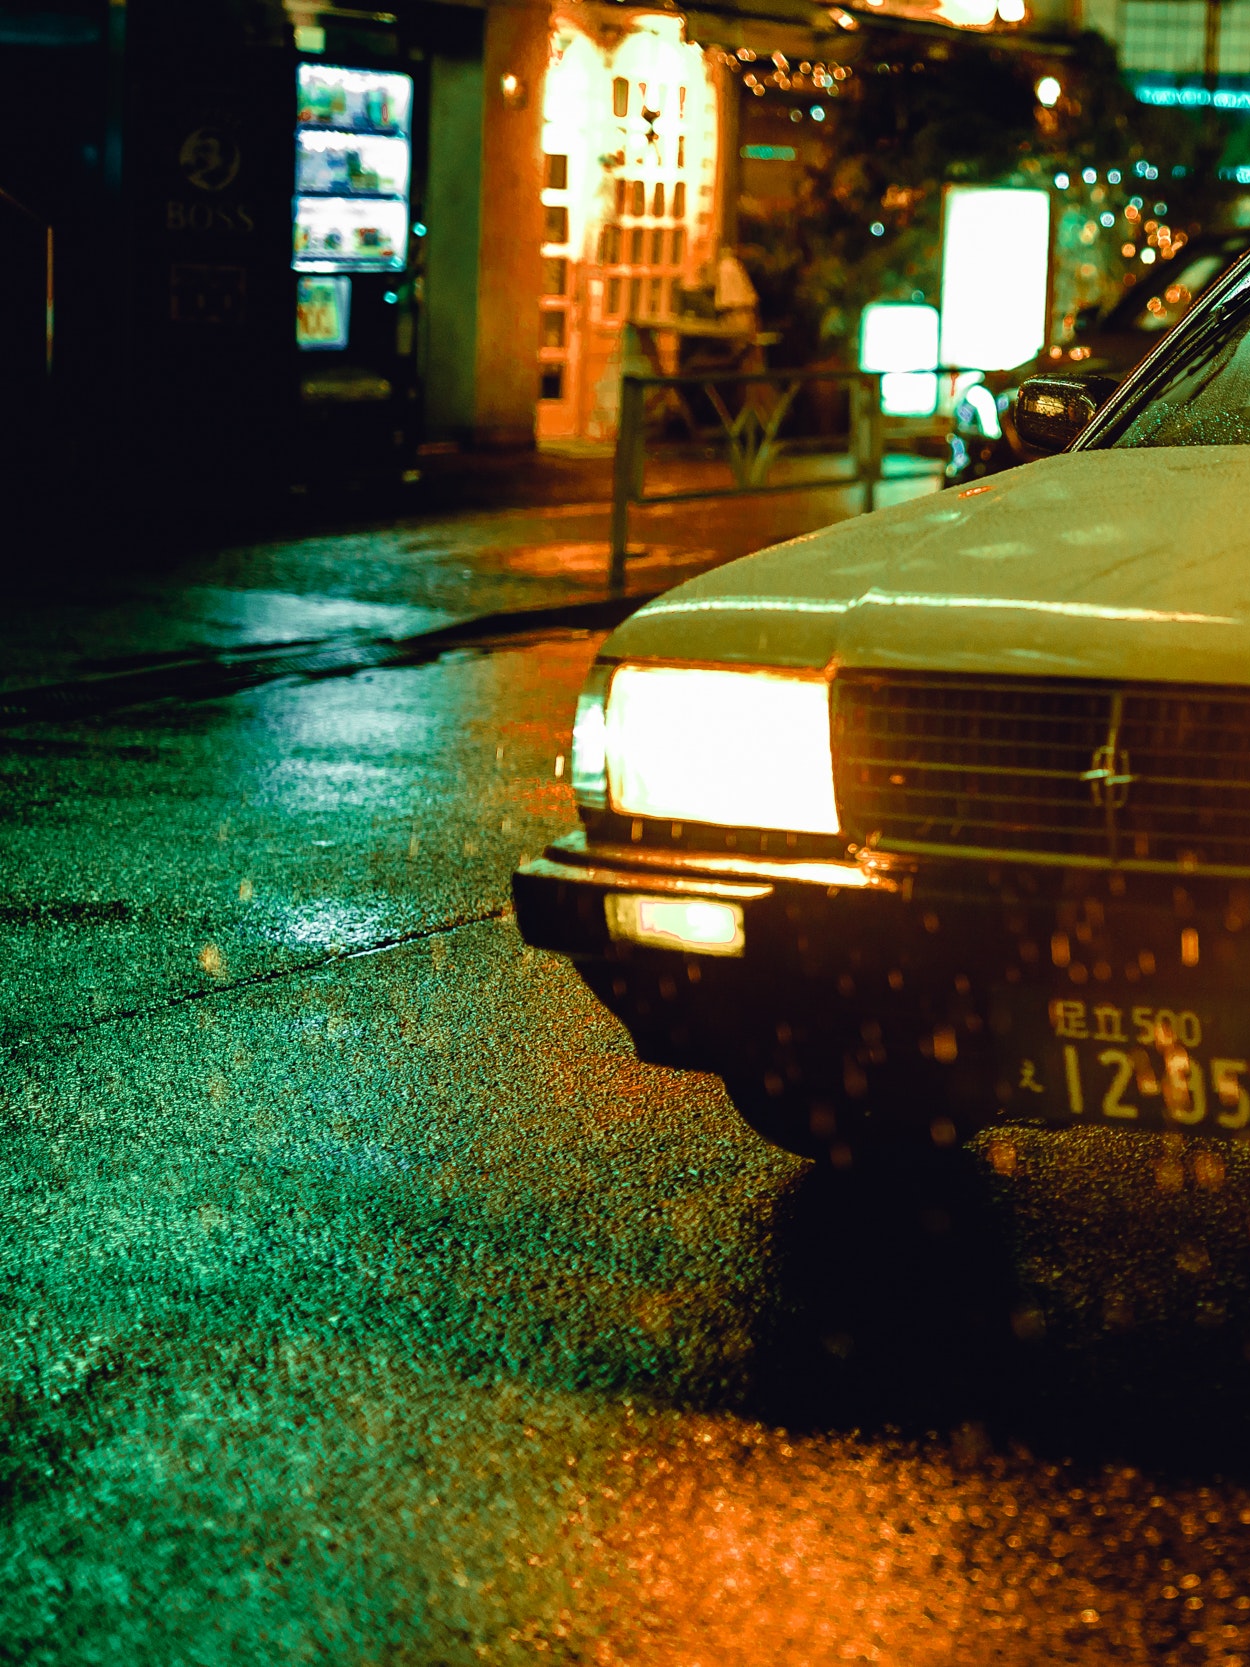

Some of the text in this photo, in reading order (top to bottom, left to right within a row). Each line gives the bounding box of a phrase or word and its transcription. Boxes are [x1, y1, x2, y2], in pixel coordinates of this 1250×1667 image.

[166, 200, 255, 232] BOSS
[1054, 999, 1203, 1048] 足立 500
